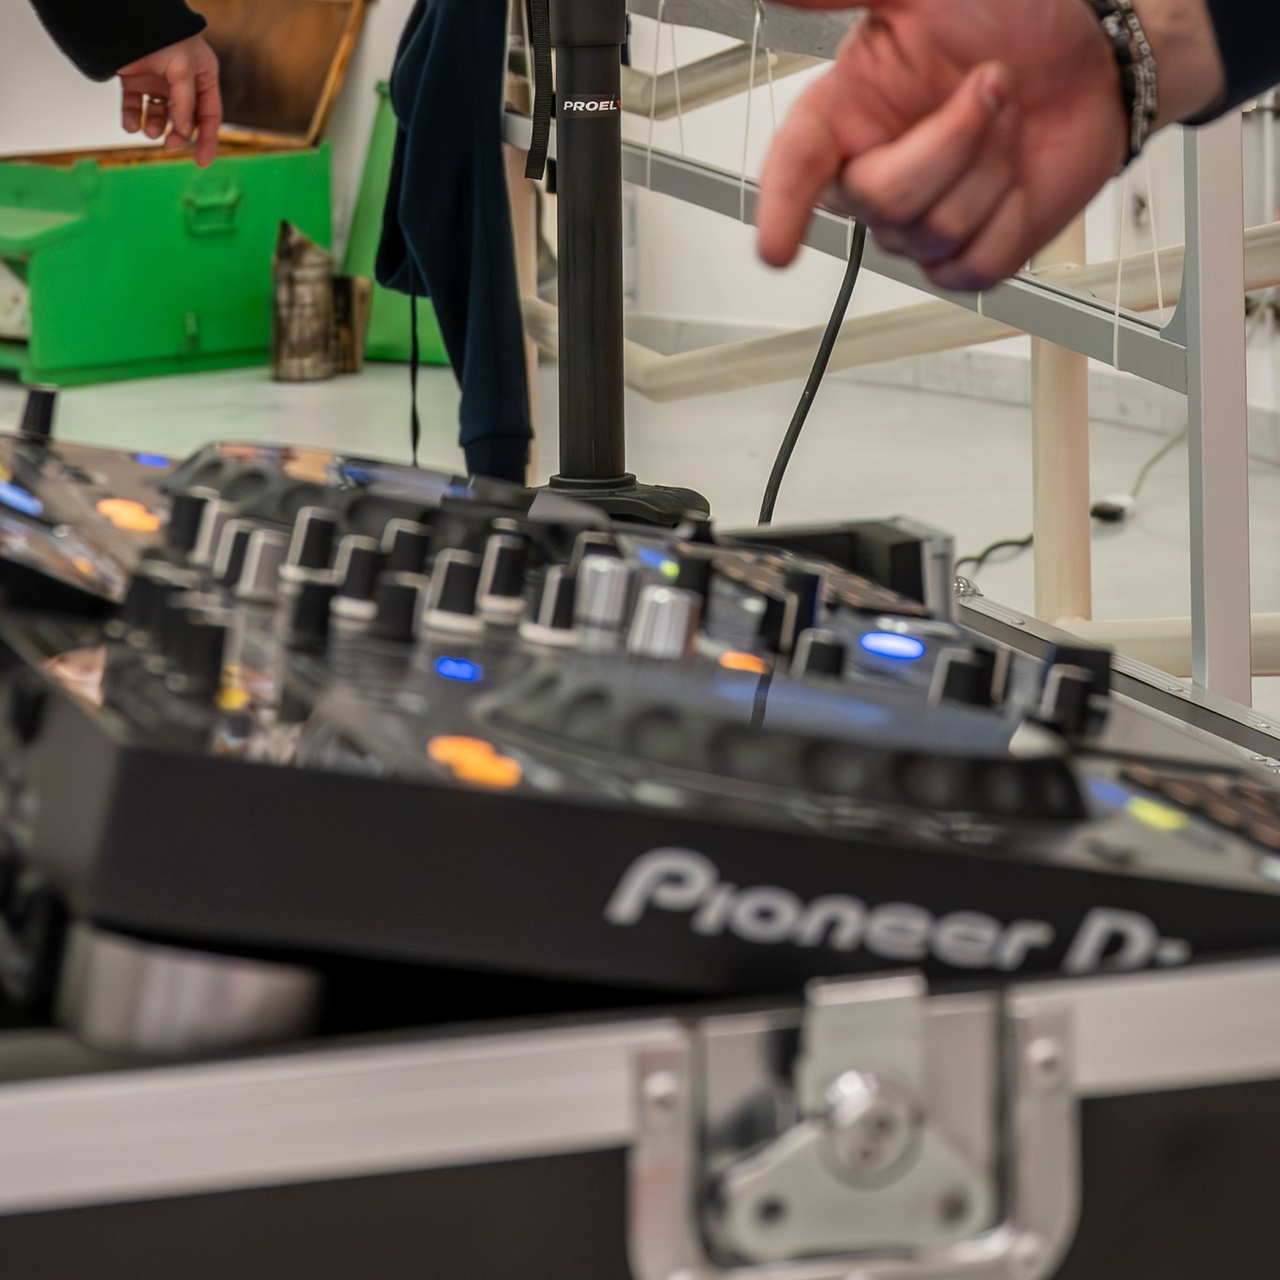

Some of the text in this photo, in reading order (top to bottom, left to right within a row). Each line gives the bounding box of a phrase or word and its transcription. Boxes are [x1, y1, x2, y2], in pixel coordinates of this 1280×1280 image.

[563, 100, 617, 112] PROEL
[604, 846, 1192, 974] Pioneer D
